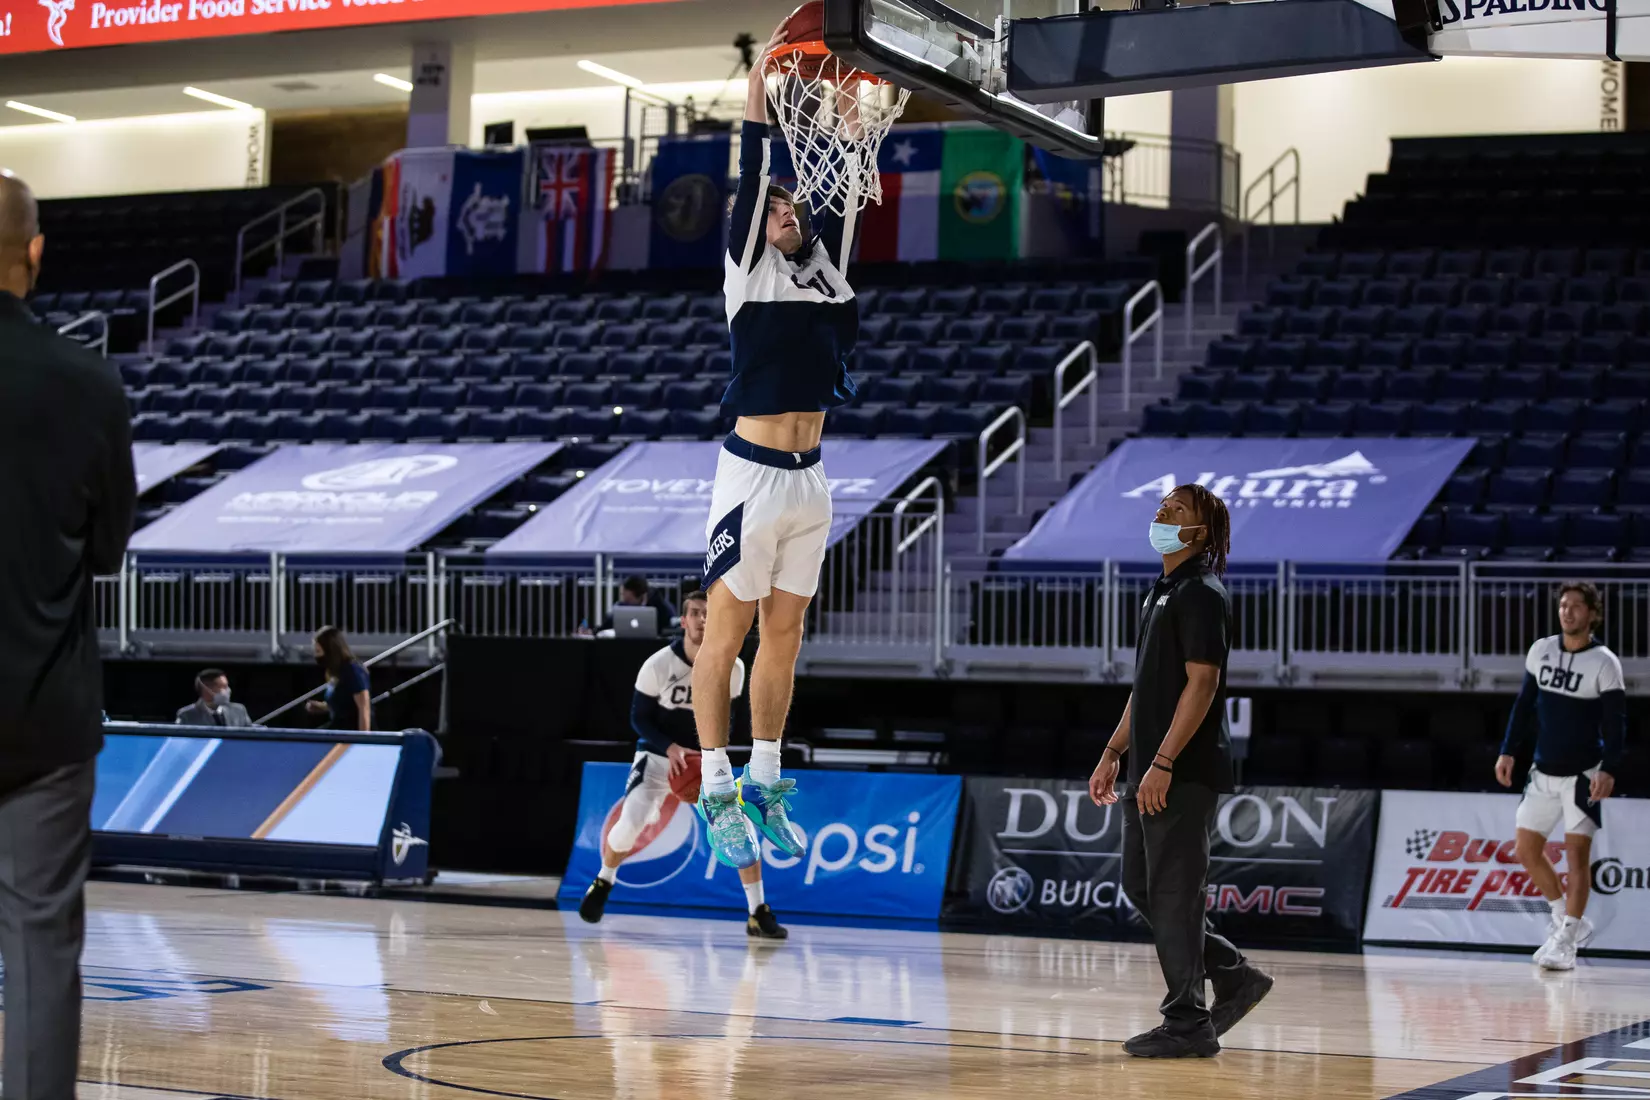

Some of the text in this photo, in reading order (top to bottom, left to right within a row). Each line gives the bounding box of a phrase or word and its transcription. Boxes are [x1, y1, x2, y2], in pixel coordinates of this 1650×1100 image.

[90, 0, 183, 29] Provider
[188, 0, 245, 21] Food
[1601, 61, 1619, 132] WOME
[1121, 471, 1359, 498] Altura
[1539, 664, 1584, 693] CBU
[996, 787, 1338, 848] DUON
[1391, 867, 1479, 909] TIRE
[1590, 857, 1650, 895] Con
[1040, 878, 1134, 910] BUICK
